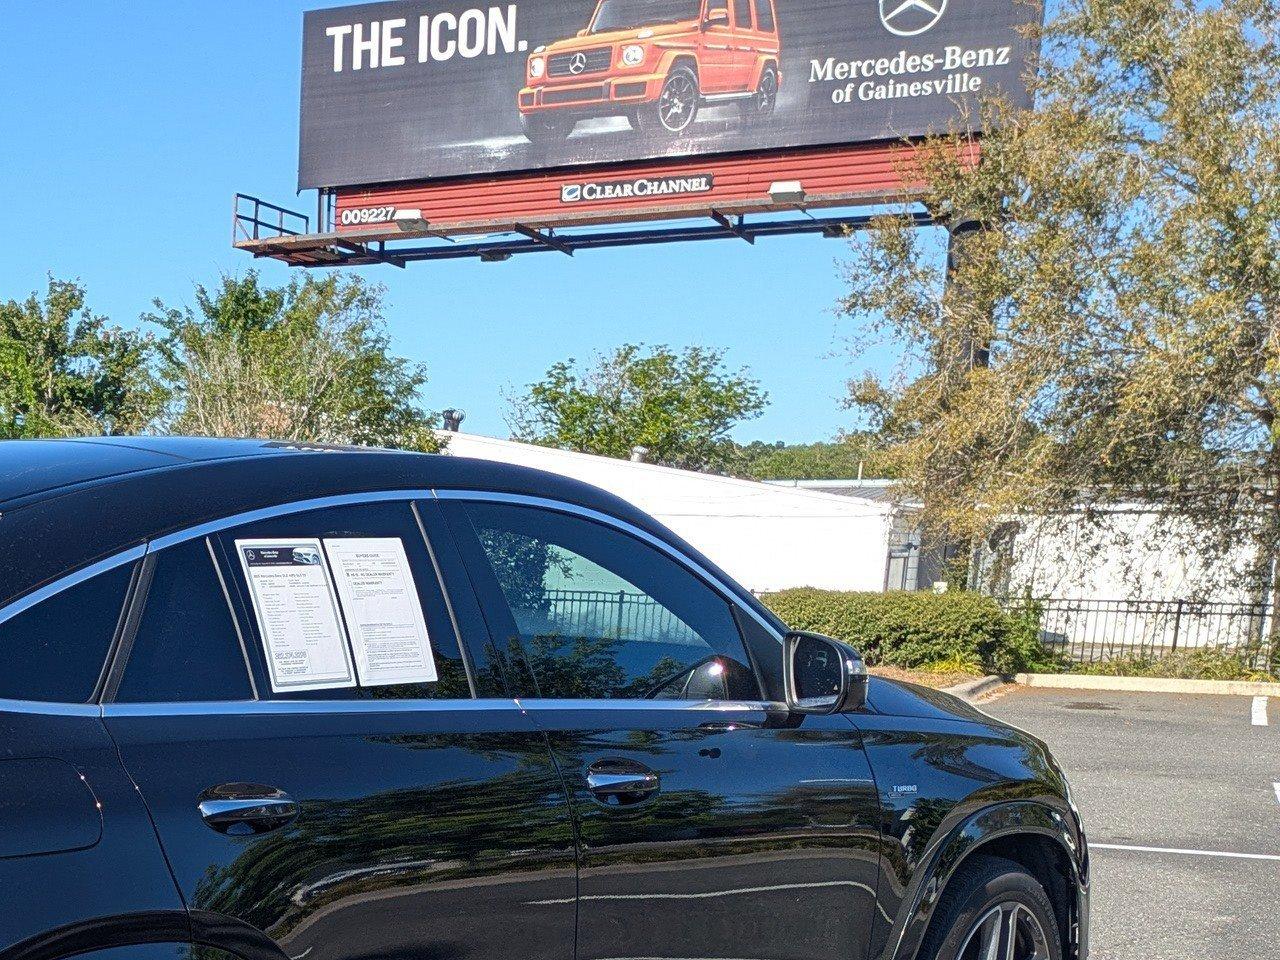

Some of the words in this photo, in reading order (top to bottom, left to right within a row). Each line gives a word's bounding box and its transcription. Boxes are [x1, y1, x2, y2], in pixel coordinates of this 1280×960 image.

[325, 18, 406, 72] THE
[418, 4, 528, 63] ICON.
[808, 45, 1010, 83] Mercedes-Benz
[831, 83, 854, 104] of
[858, 72, 982, 102] Gainesville
[341, 206, 395, 225] 009227
